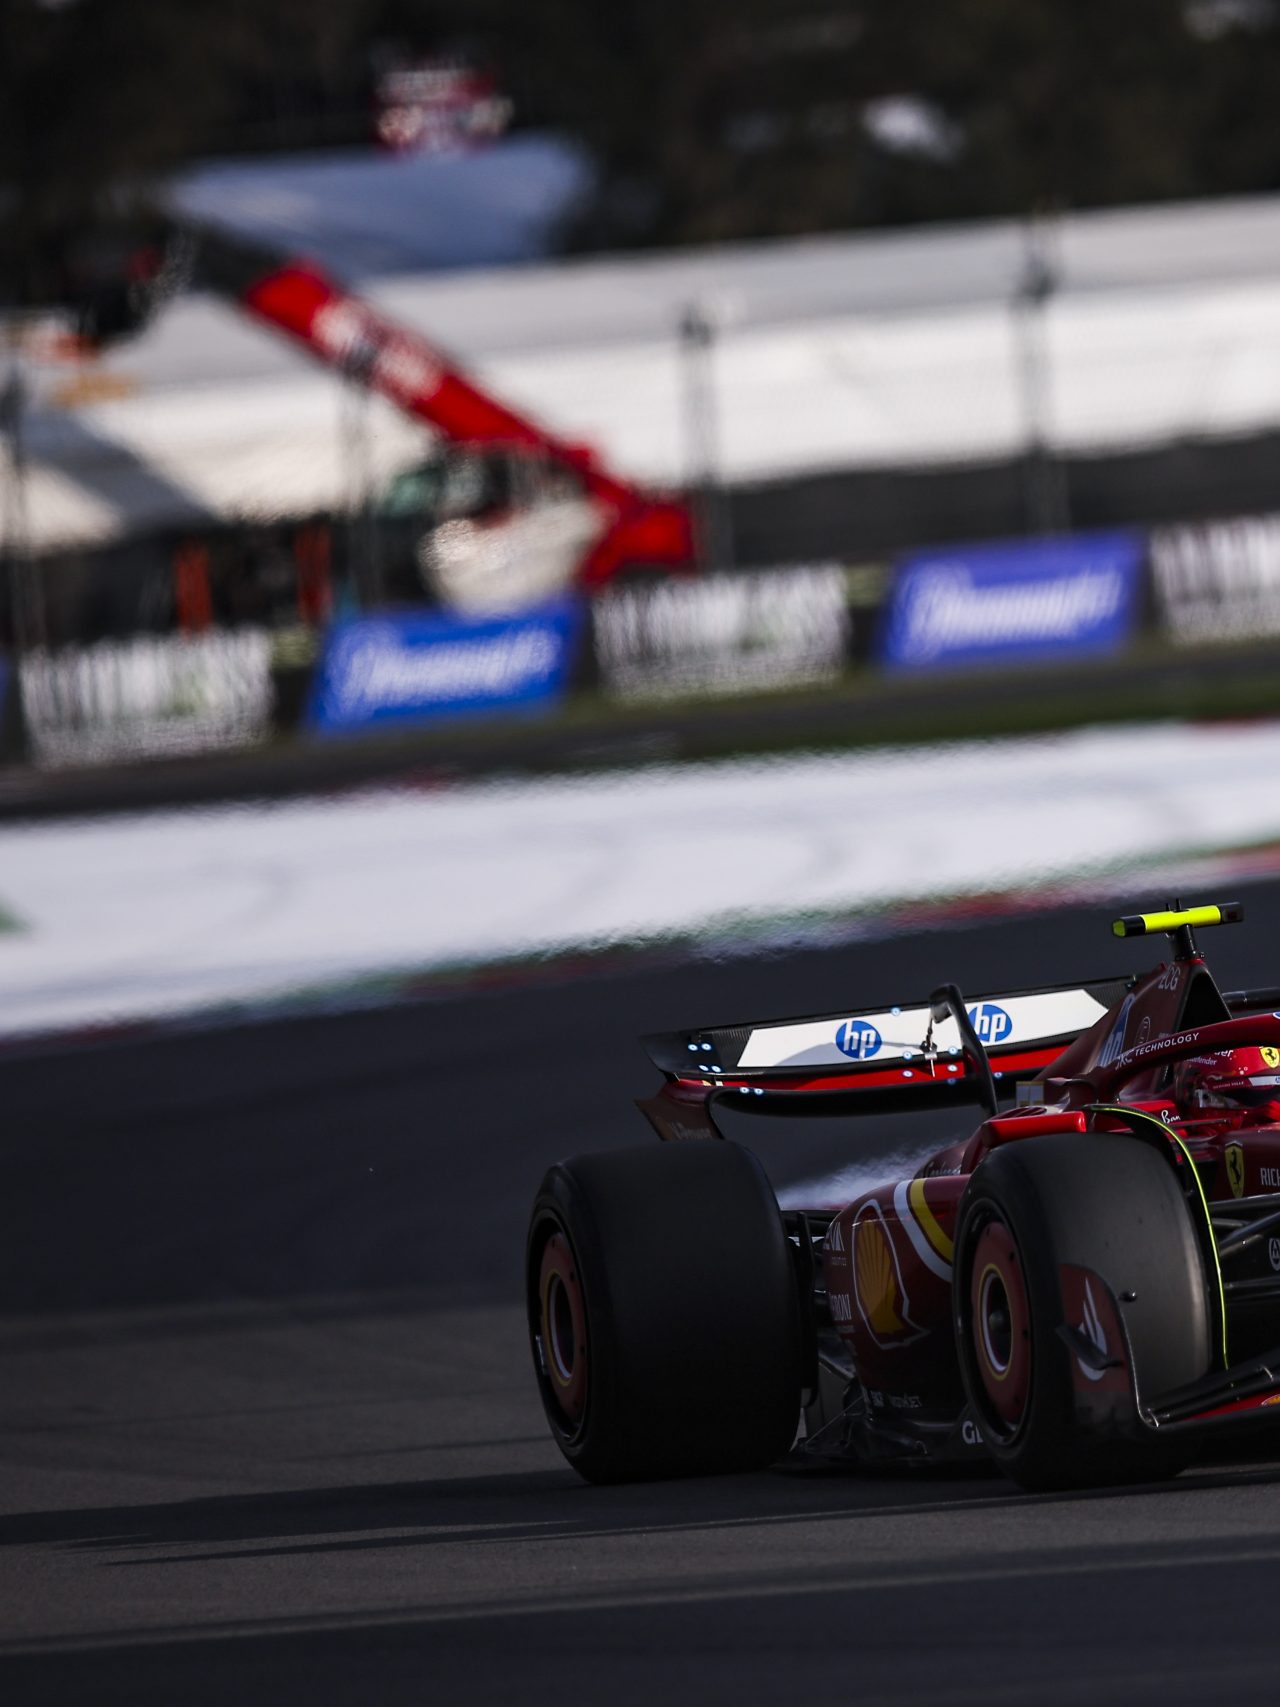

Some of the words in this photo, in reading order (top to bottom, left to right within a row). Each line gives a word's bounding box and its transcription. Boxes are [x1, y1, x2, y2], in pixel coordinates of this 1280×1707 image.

[843, 1021, 877, 1059] hp
[974, 1004, 1007, 1043] hp
[1134, 1032, 1200, 1057] TECHNOLOGY
